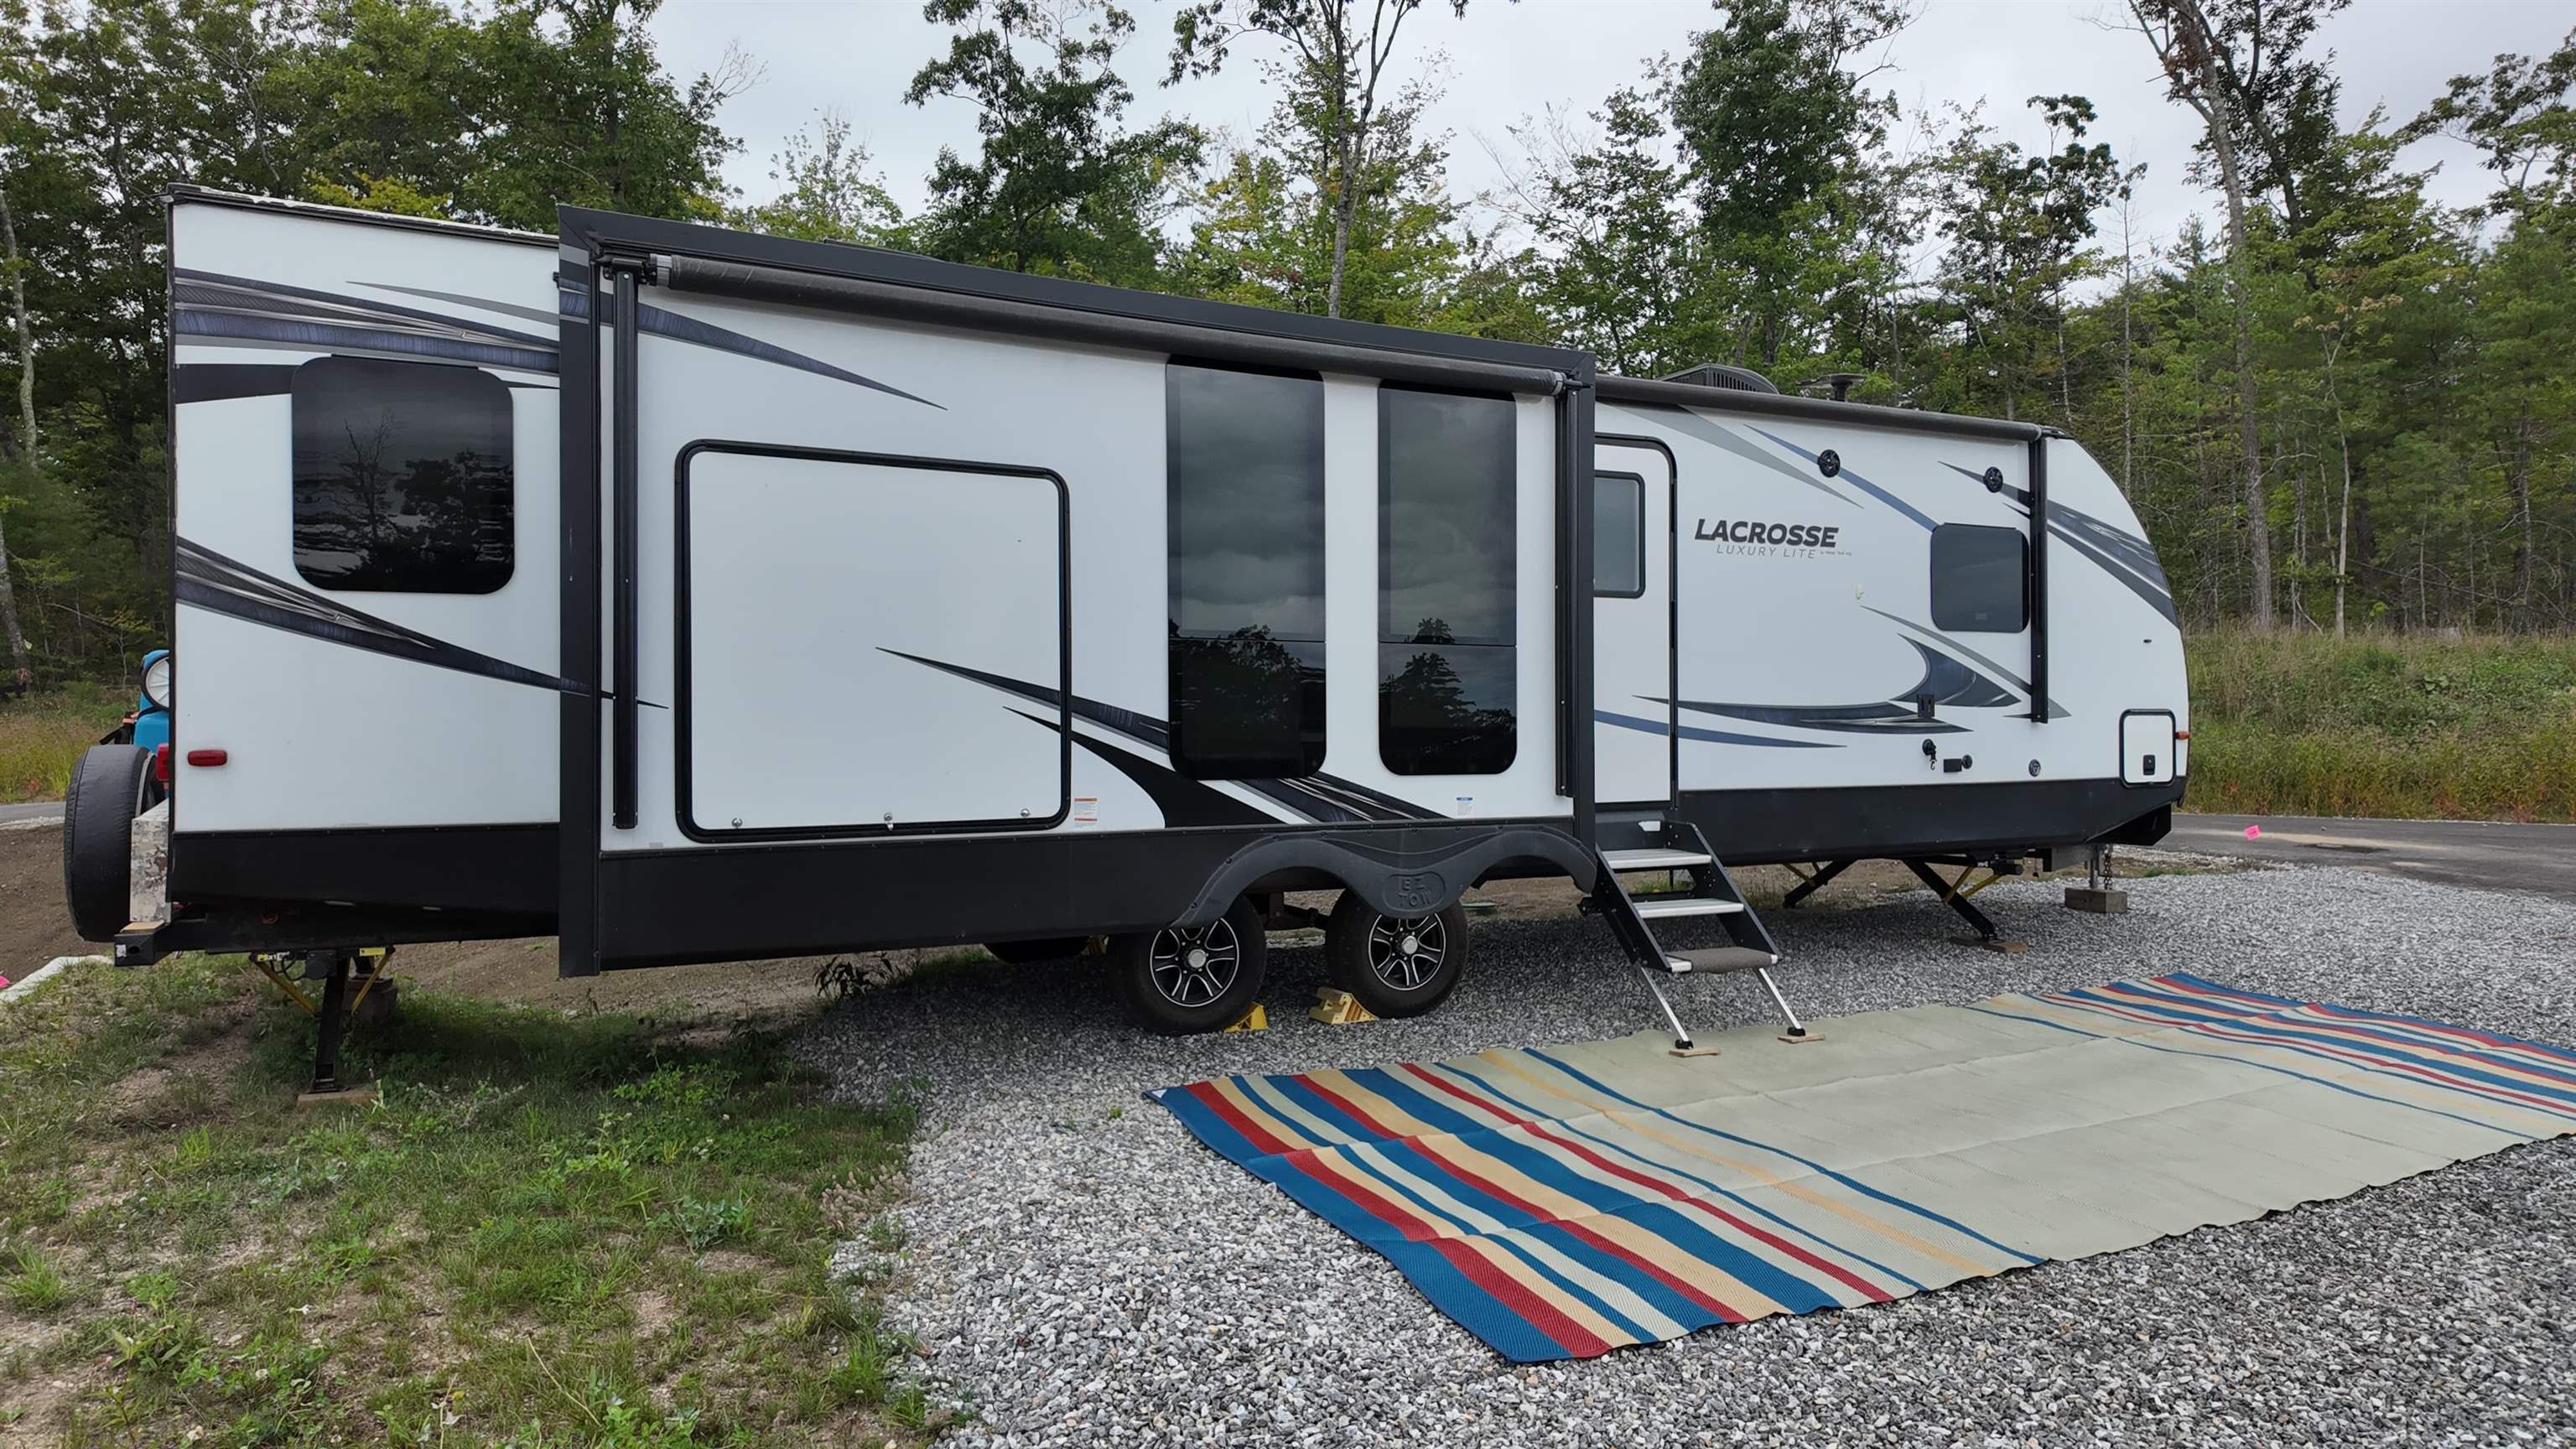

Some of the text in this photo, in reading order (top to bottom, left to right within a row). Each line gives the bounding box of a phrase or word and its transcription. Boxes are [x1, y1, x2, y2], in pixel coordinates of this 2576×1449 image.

[1695, 518, 1839, 548] LACROSSE
[1716, 544, 1777, 557] LUXURY
[1783, 548, 1816, 559] LITE
[1399, 877, 1426, 891] EZ
